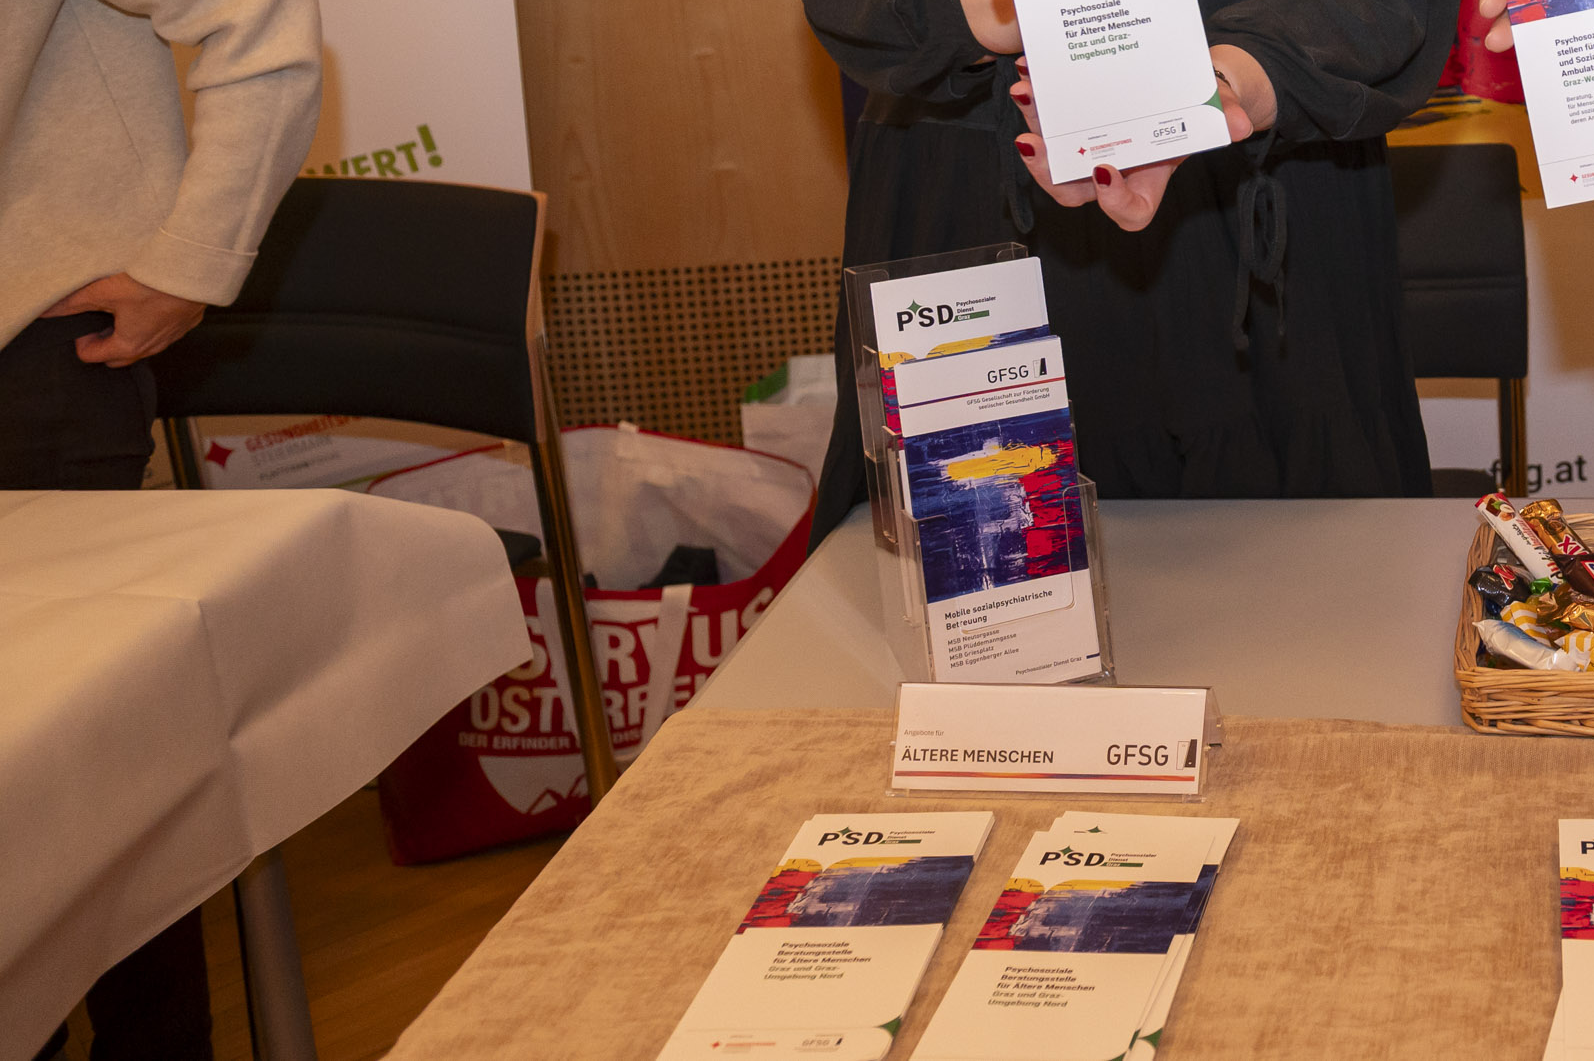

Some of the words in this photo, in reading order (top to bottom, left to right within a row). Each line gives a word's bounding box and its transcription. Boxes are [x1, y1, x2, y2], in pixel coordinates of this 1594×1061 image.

[1060, 0, 1121, 16] Psychosoziale
[1063, 9, 1129, 27] Beratungsstelle
[1065, 30, 1078, 39] für
[1080, 25, 1106, 36] Ältere
[1108, 16, 1151, 31] Menschen
[1068, 41, 1088, 50] Graz
[1090, 37, 1106, 46] und
[1108, 32, 1131, 42] Graz-
[1070, 47, 1117, 62] Umgebung
[1119, 41, 1139, 52] Nord
[1557, 46, 1583, 57] stellen
[1559, 58, 1574, 67] und
[1153, 126, 1176, 137] GFSG
[956, 295, 996, 307] Psychosozialer
[897, 305, 954, 331] PSD
[988, 365, 1029, 384] GFSG
[945, 607, 970, 620] Mobile
[973, 590, 1053, 614] sozialpsychiatrische
[904, 729, 933, 737] Angebote
[902, 746, 958, 762] ÄLTERE
[963, 749, 1054, 764] MENSCHEN
[1106, 744, 1169, 766] GFSG
[818, 832, 883, 846] PSD
[1039, 851, 1105, 866] PSD
